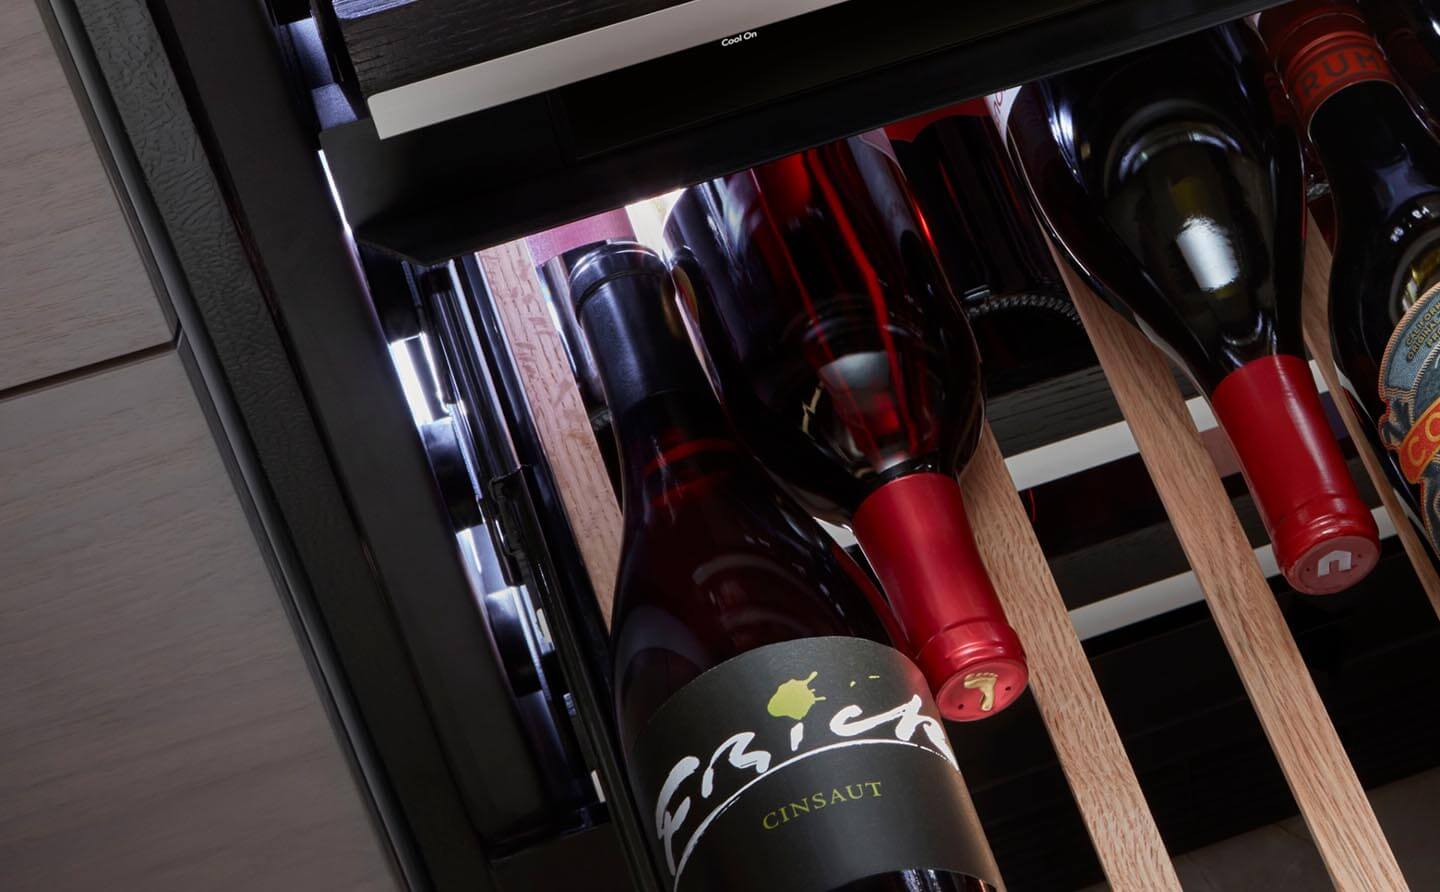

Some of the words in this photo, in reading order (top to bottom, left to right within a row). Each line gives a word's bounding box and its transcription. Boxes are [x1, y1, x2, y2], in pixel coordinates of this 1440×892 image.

[721, 34, 742, 46] Cool
[743, 31, 757, 40] On
[762, 781, 882, 831] CINSAUT
